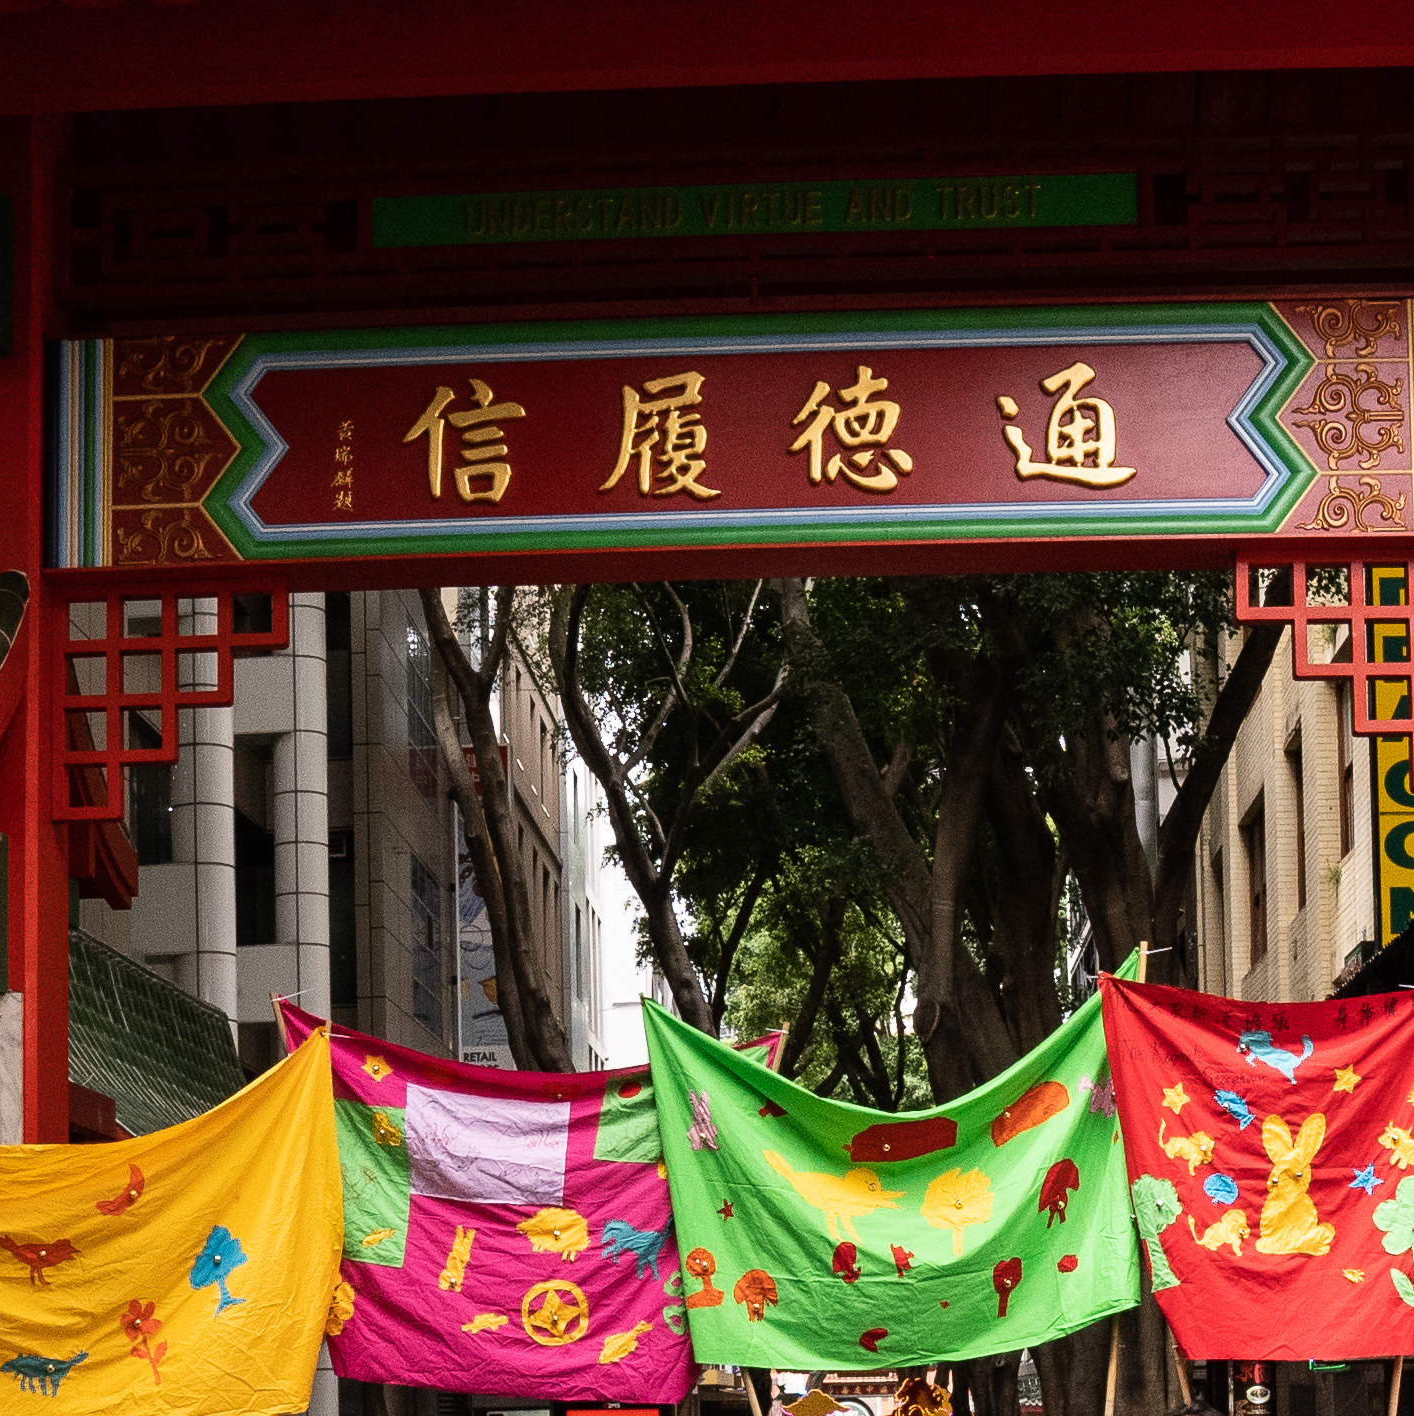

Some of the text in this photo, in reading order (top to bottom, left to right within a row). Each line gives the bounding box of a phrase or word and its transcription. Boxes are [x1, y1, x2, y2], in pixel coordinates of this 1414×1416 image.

[464, 182, 1042, 235] UNDERSTAND VIRTUE AND TRUST
[463, 1051, 498, 1063] RETAIL
